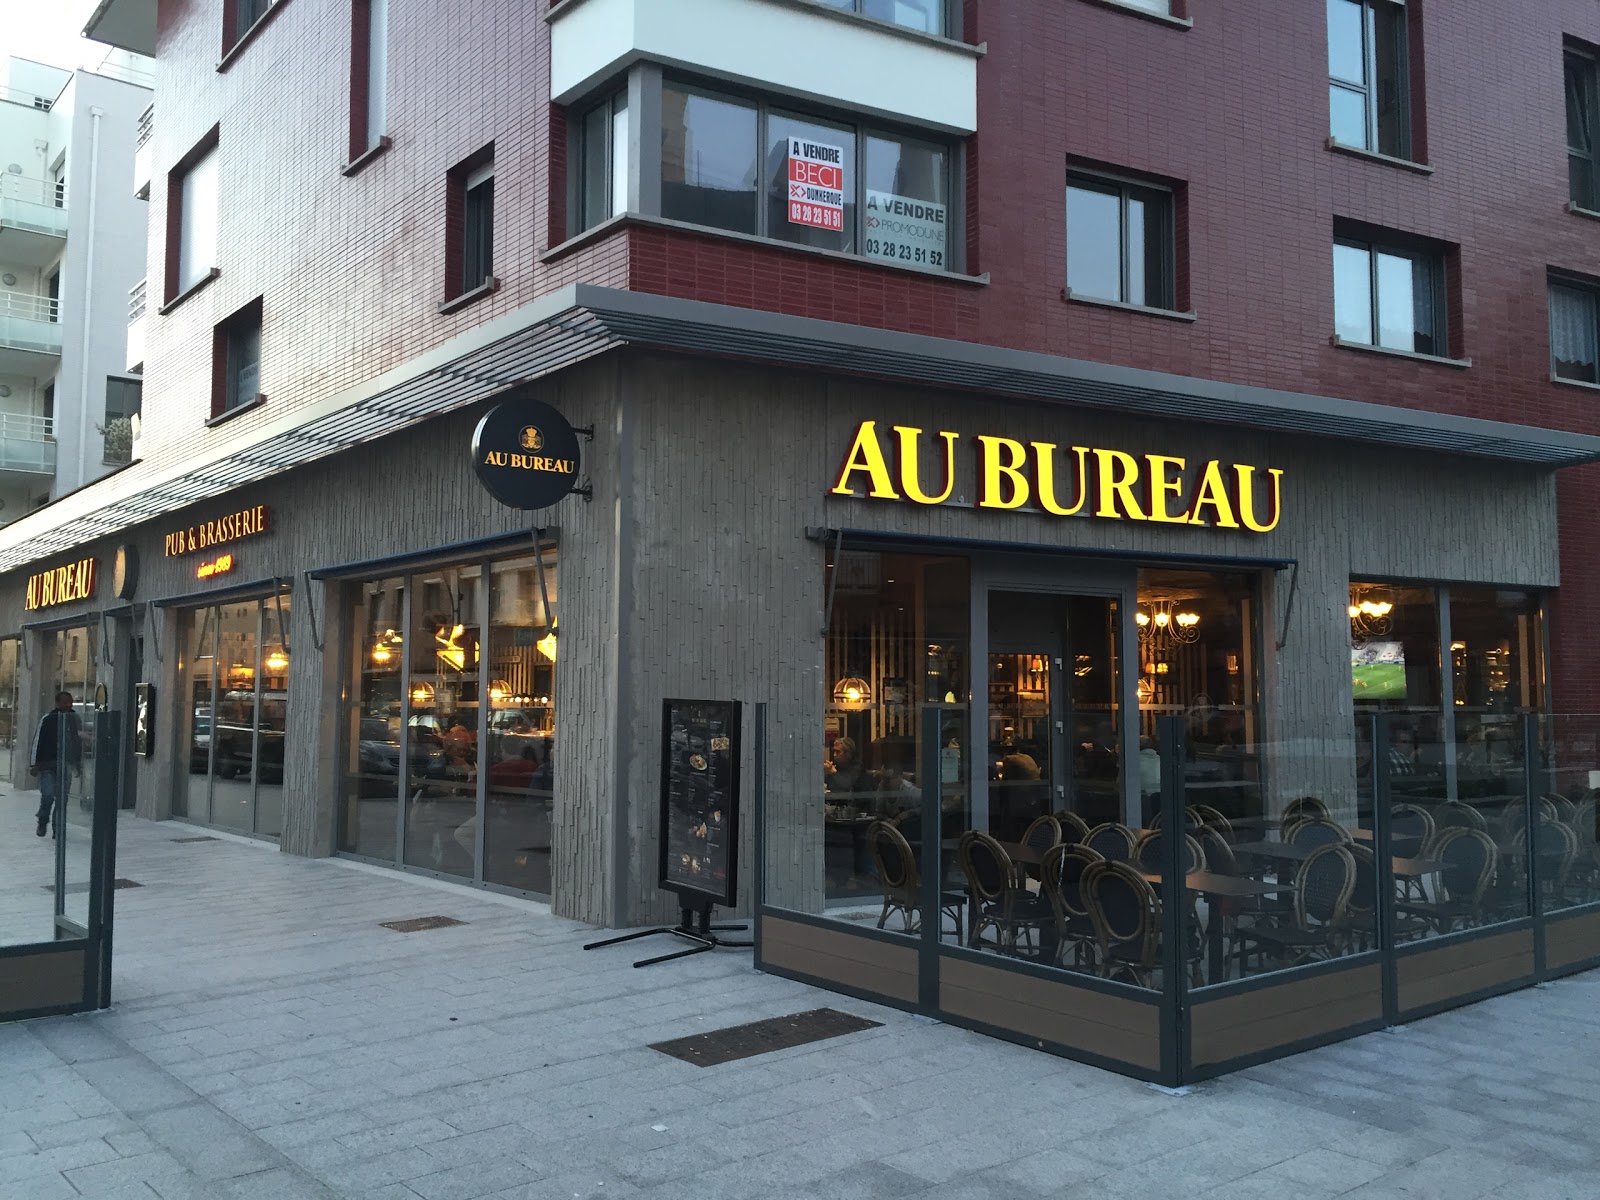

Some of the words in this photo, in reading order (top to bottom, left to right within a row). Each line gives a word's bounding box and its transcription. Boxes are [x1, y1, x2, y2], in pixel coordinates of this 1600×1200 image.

[793, 141, 800, 156] A
[803, 143, 840, 164] VENDRE
[795, 160, 837, 189] BECI
[806, 187, 842, 206] DUNKERQUE
[868, 196, 878, 210] A
[884, 198, 944, 223] VENDRE
[792, 203, 801, 220] 03
[802, 206, 812, 223] 28
[813, 209, 822, 225] 23
[824, 211, 832, 226] 51
[833, 213, 841, 227] 51
[881, 219, 944, 242] PROMODUNE
[866, 239, 879, 254] 03
[883, 241, 895, 257] 28
[899, 245, 911, 260] 23
[915, 248, 926, 263] 51
[930, 251, 942, 266] 52
[484, 451, 508, 467] AU
[511, 453, 574, 474] BUREAU
[830, 420, 959, 505] AU
[975, 434, 1284, 533] BUREAU
[165, 532, 185, 557] PUB
[188, 528, 196, 551] &
[199, 505, 264, 548] BRASSERIE
[25, 573, 42, 611] AU
[41, 557, 94, 607] BUREAU
